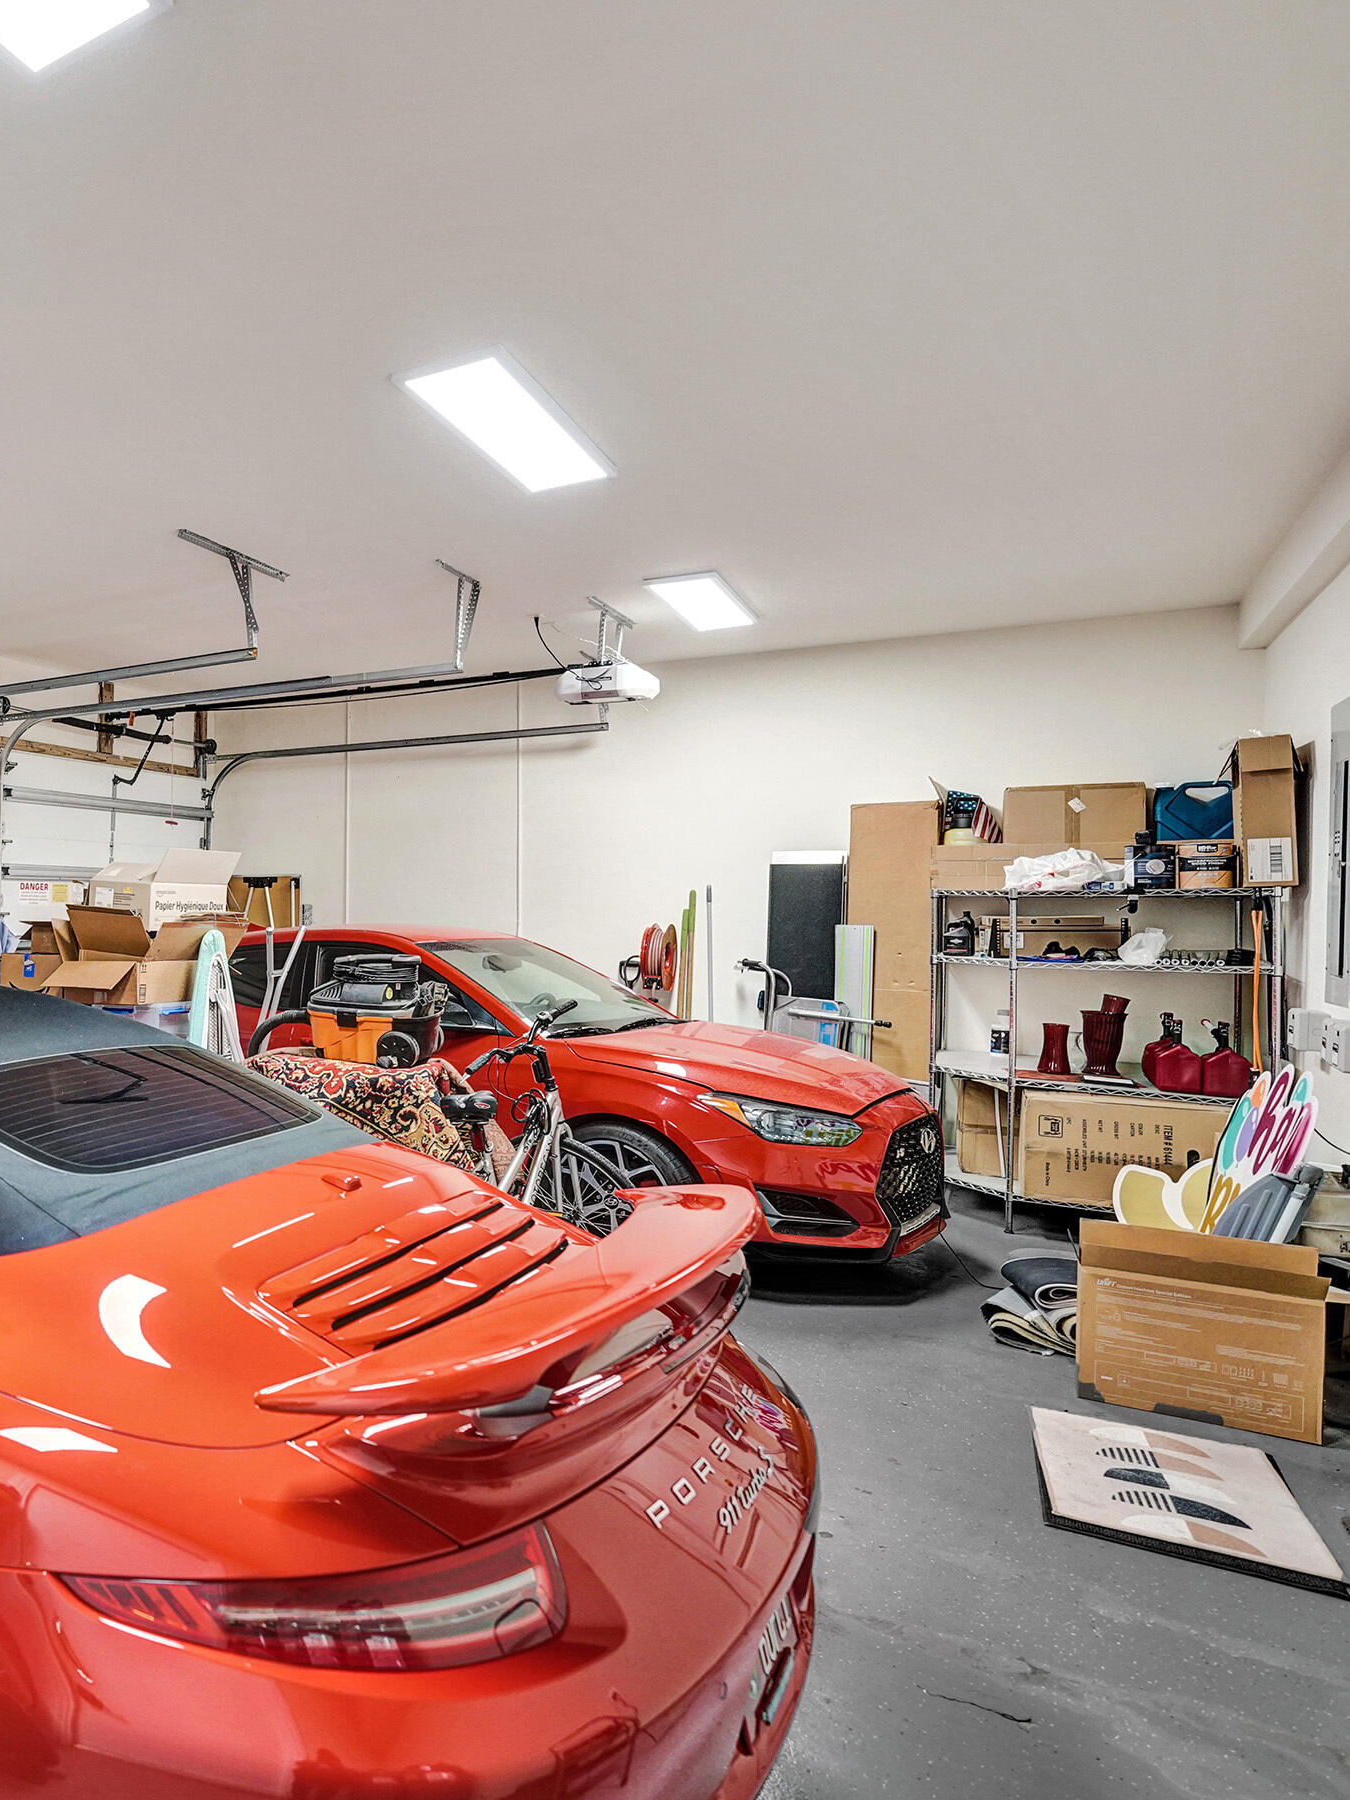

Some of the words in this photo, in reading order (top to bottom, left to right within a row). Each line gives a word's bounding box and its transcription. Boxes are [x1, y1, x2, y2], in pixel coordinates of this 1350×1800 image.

[19, 882, 49, 891] DANGER
[155, 901, 176, 912] Papier
[176, 901, 209, 912] Hygiénique
[209, 901, 224, 911] Doux
[1163, 1125, 1173, 1141] ITEM
[644, 1384, 759, 1530] PORSCHE
[717, 1495, 743, 1535] 911
